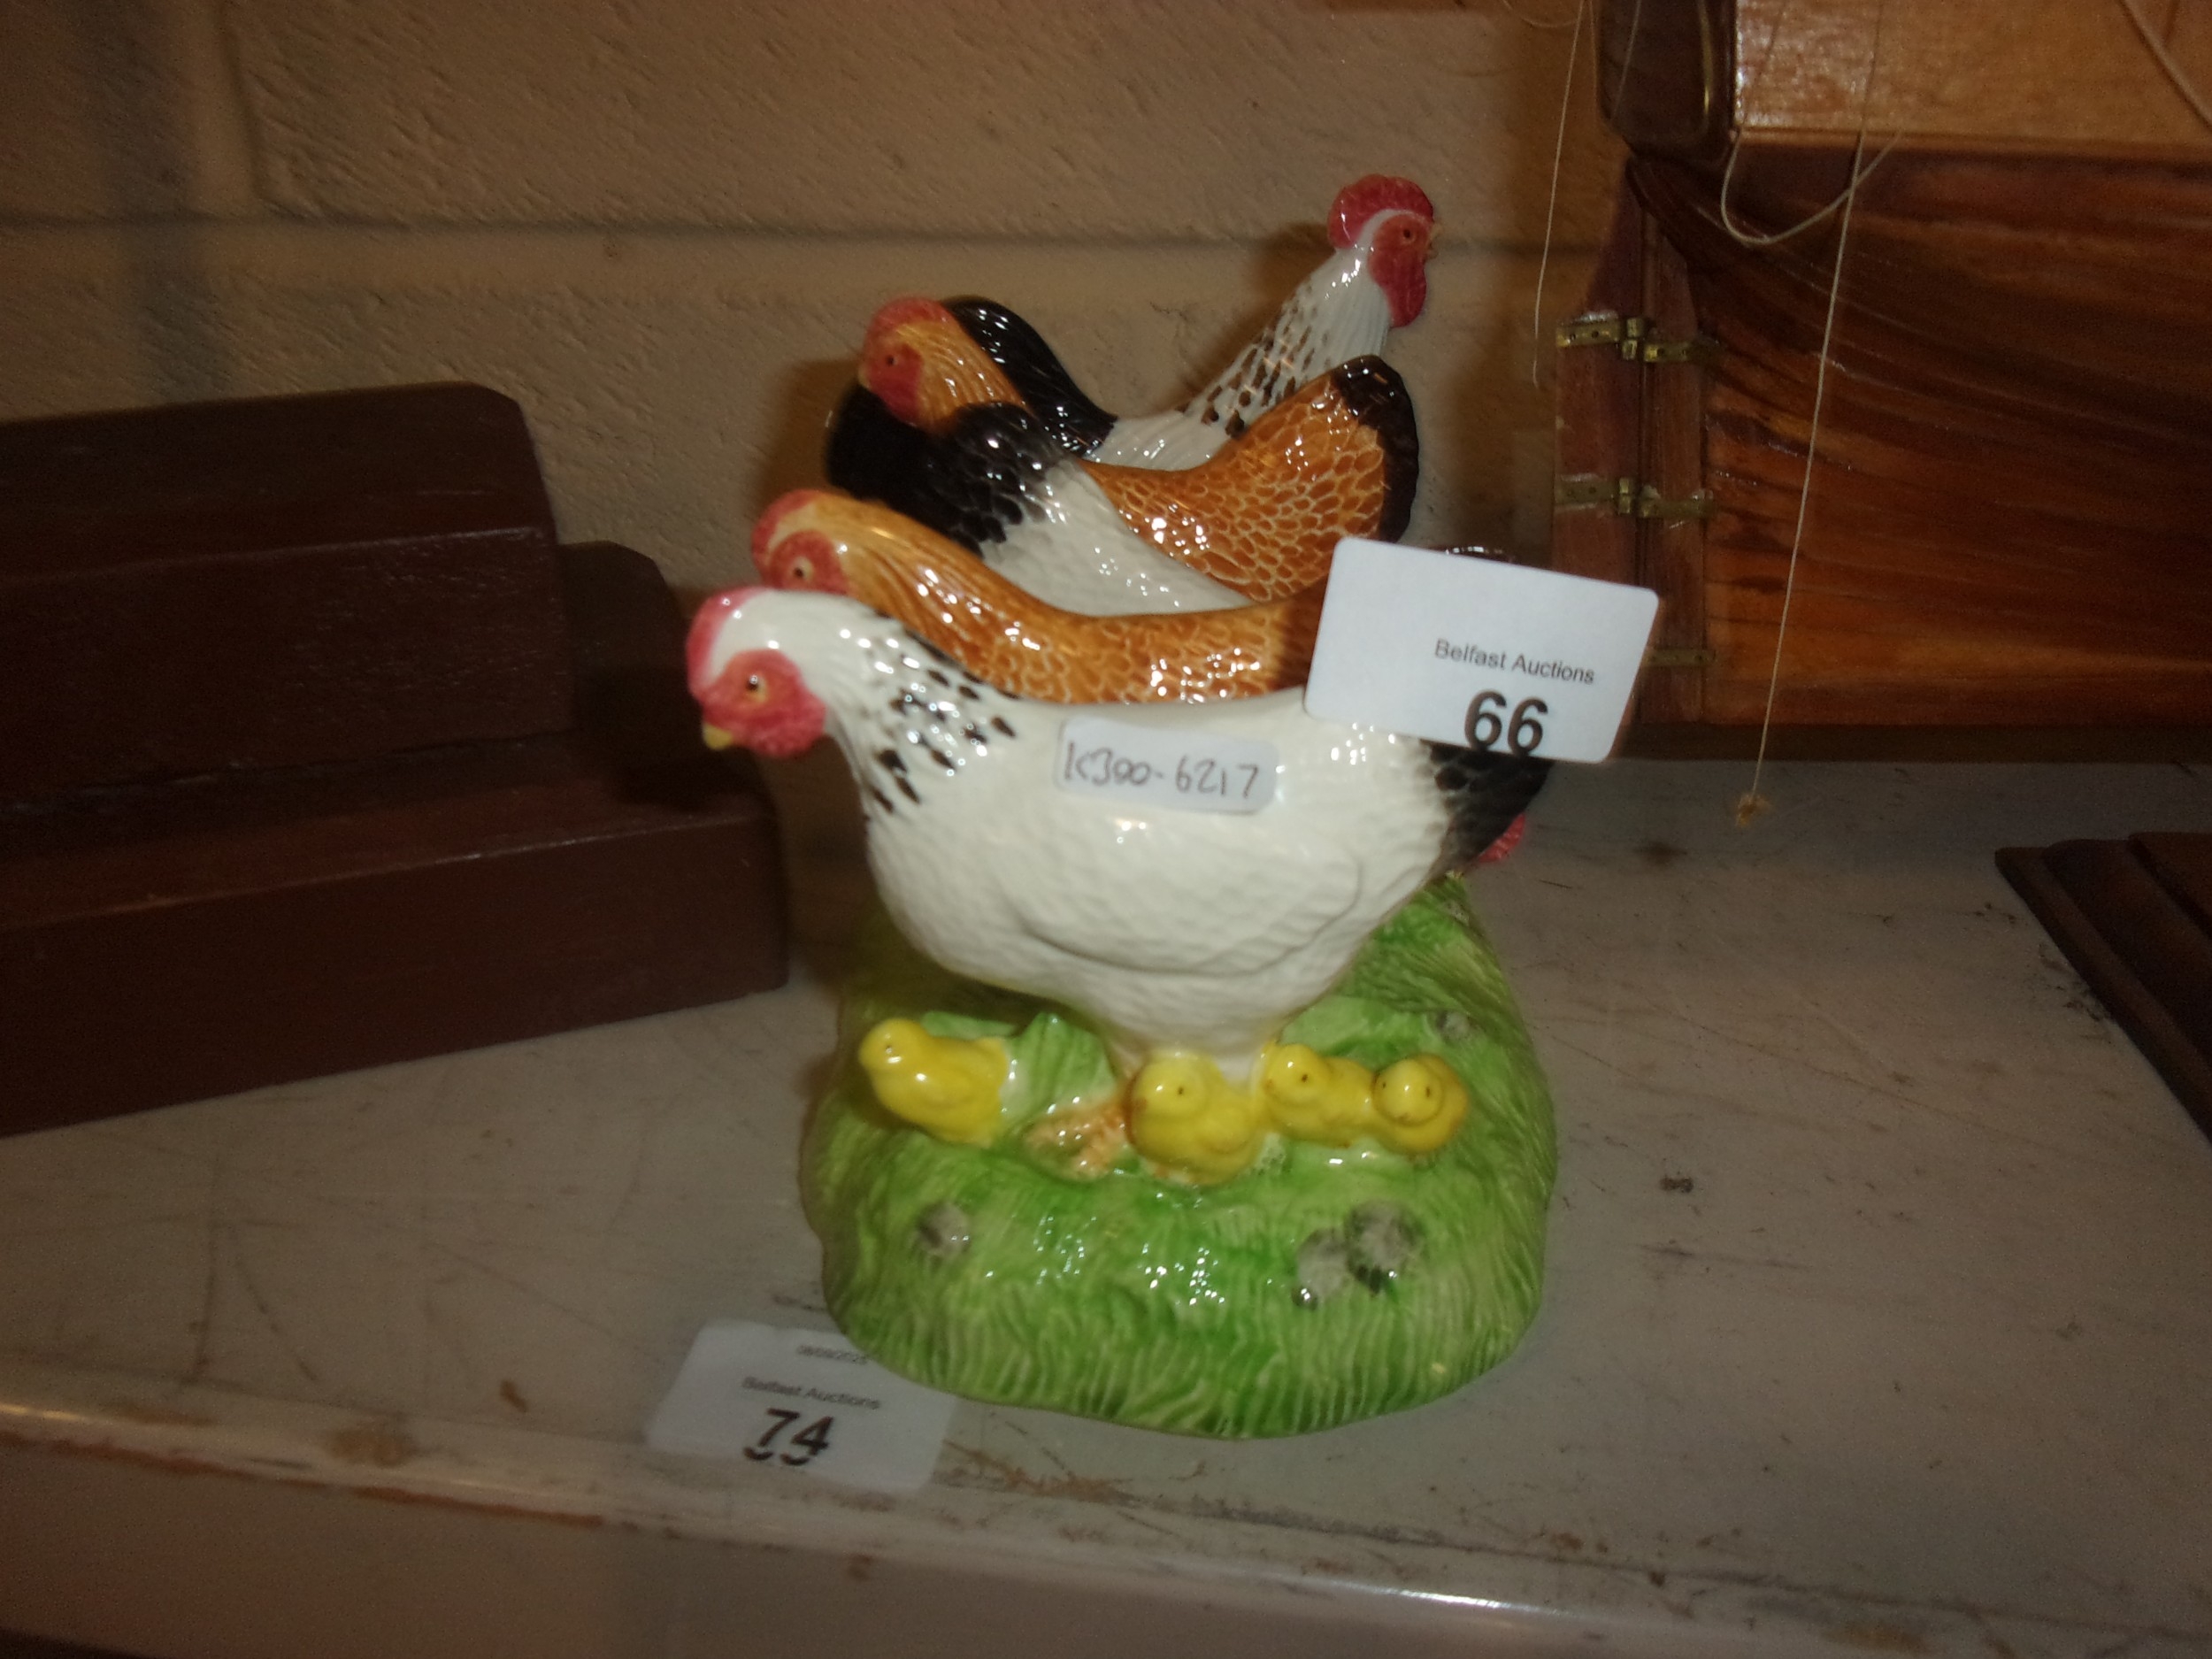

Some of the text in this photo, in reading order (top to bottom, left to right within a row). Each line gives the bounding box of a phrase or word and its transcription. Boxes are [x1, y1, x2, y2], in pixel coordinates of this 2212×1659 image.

[1434, 637, 1594, 685] Belfast Auctions
[1464, 688, 1549, 757] 66
[804, 1387, 881, 1410] Auctions
[757, 1408, 833, 1456] 74
